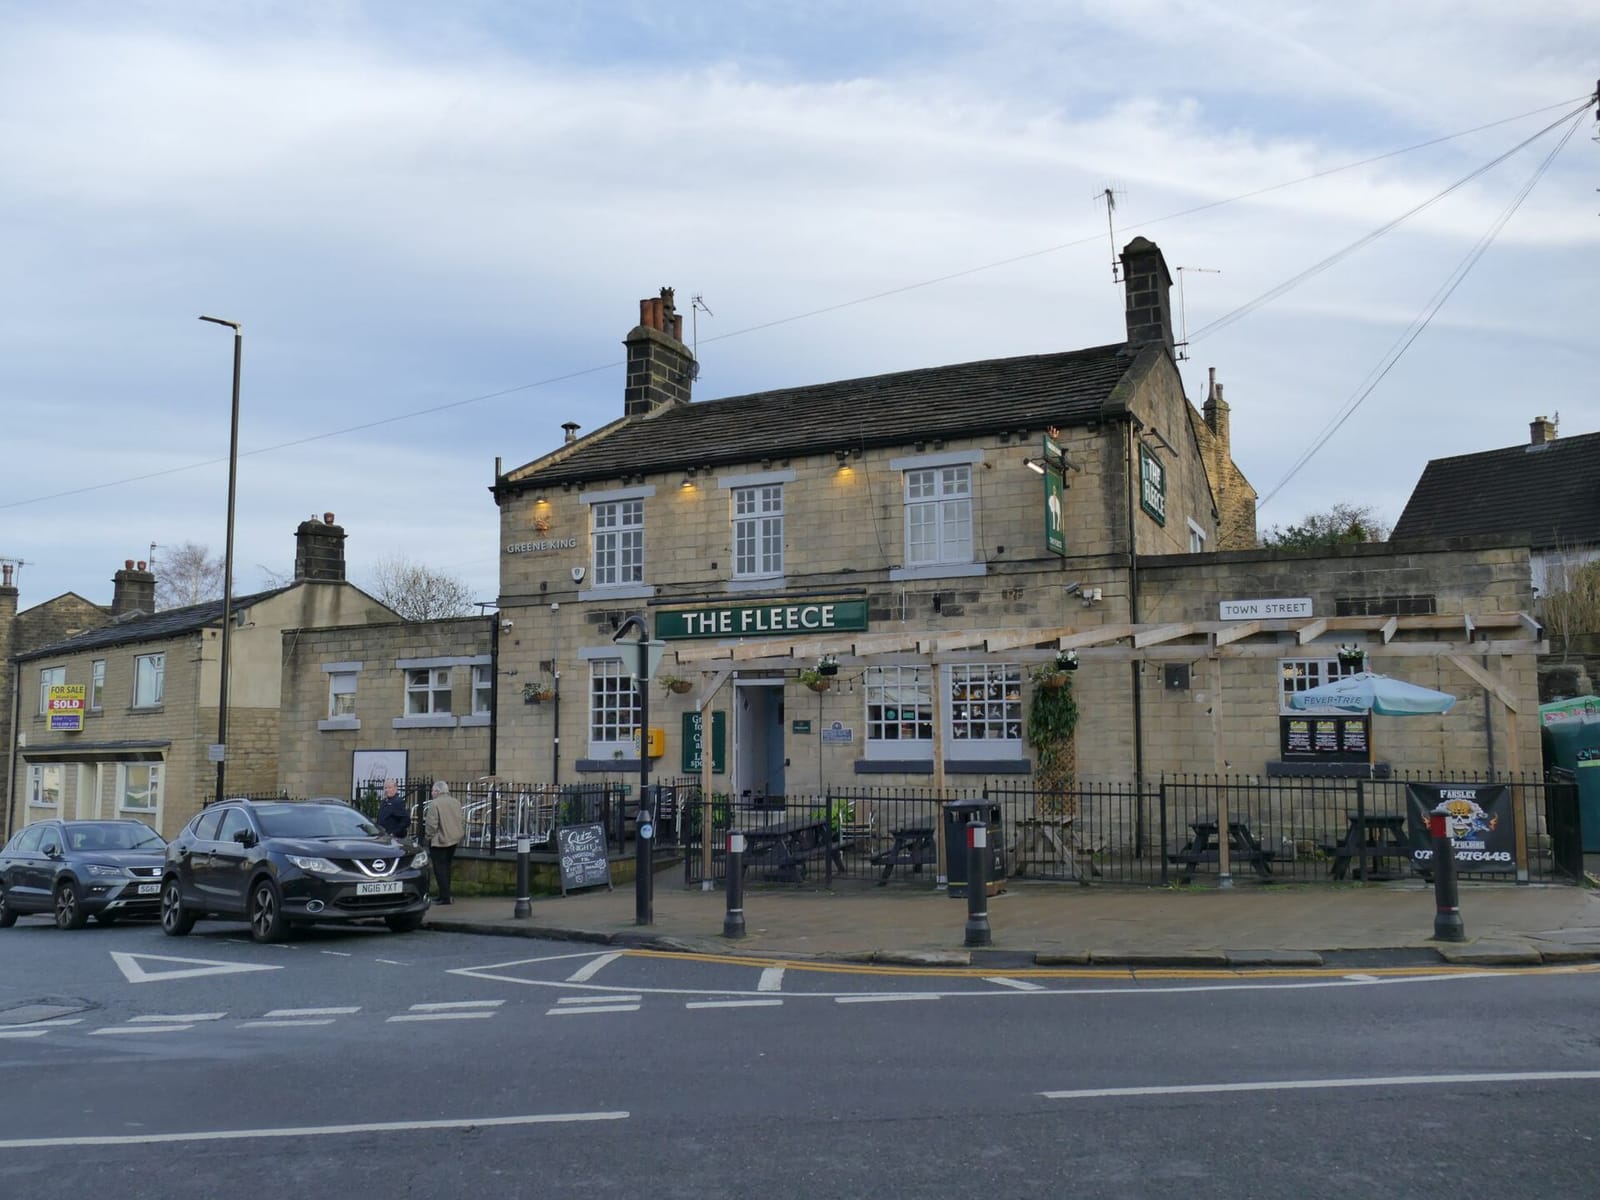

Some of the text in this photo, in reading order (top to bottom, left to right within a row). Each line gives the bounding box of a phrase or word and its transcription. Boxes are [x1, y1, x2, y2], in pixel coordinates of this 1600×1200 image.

[1142, 457, 1161, 489] THE
[507, 538, 577, 553] GREENE KING
[1225, 602, 1307, 614] TOWN STREET
[682, 605, 835, 633] THE FLEECE
[53, 700, 79, 709] SOLD
[567, 830, 597, 844] Quiz
